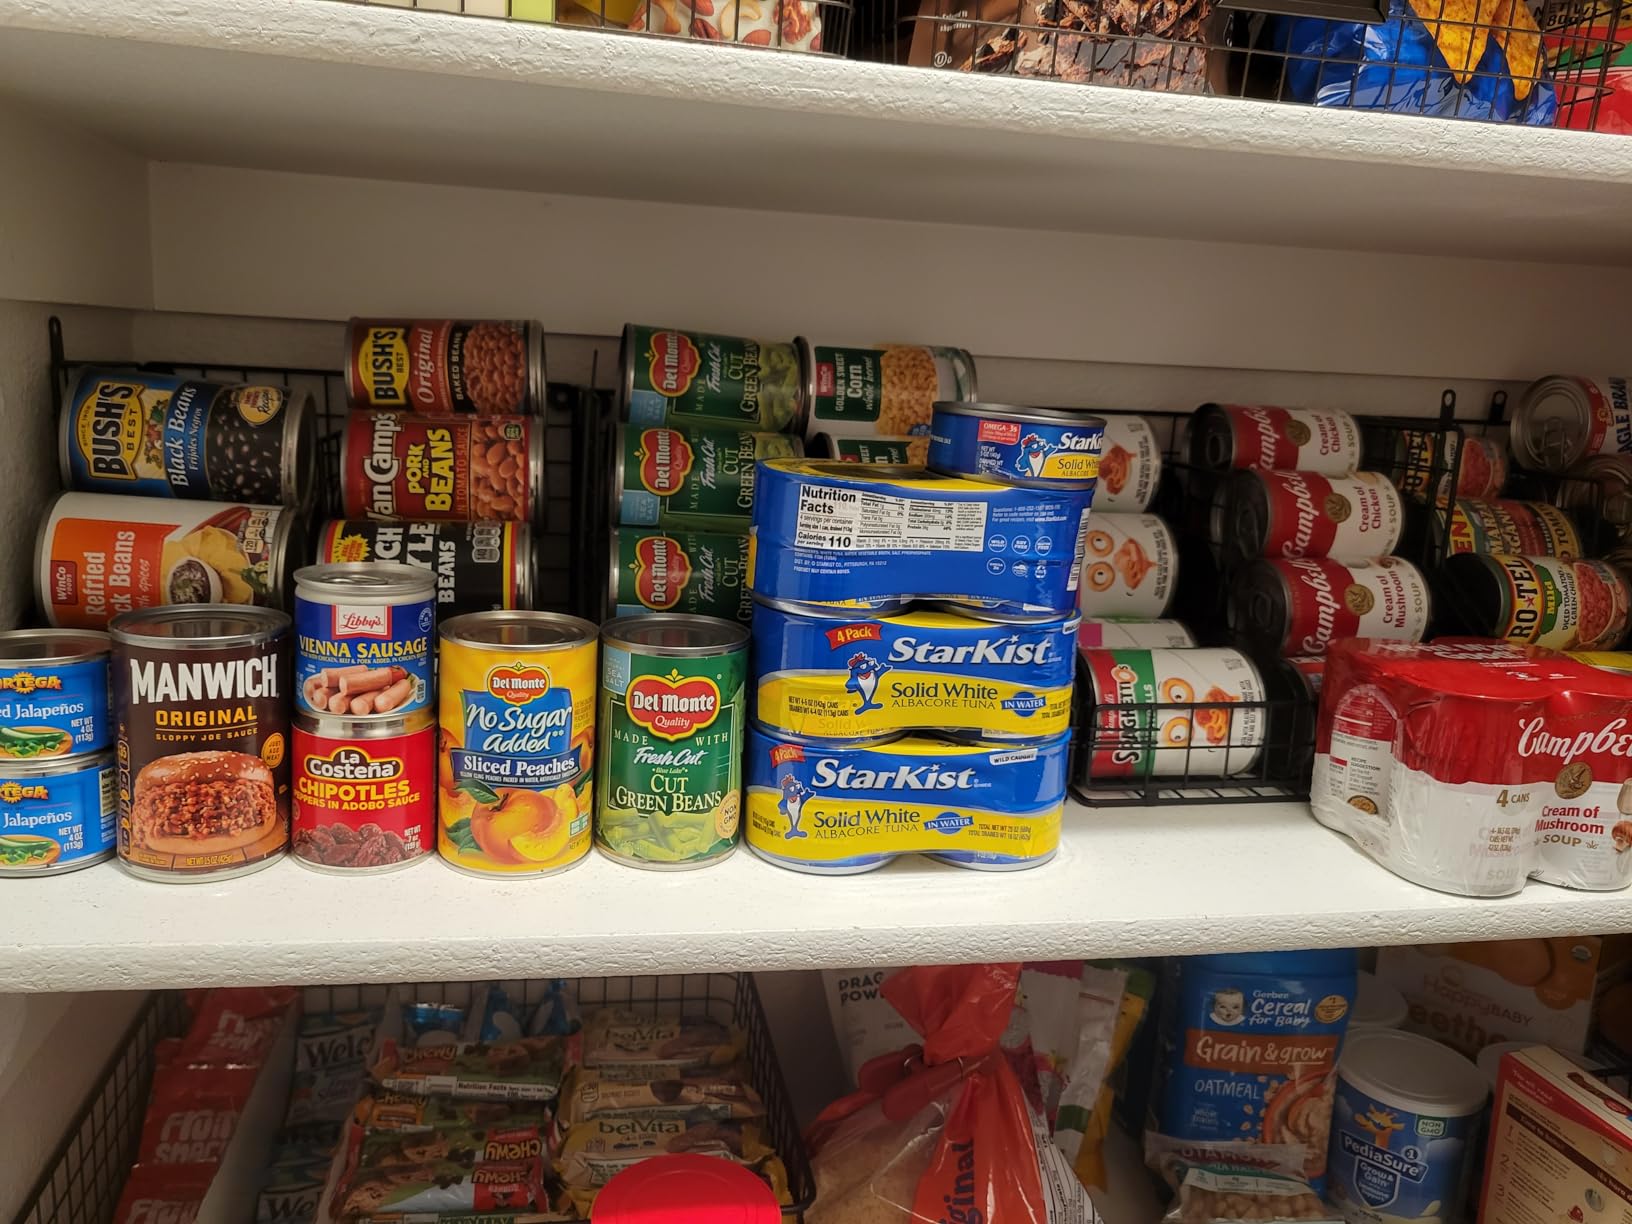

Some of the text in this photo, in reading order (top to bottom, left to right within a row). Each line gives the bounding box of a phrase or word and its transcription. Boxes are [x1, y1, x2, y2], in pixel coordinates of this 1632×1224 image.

[373, 331, 397, 399] BUSH'S
[414, 328, 435, 403] Original
[451, 332, 464, 400] BAKED BEANS
[663, 333, 679, 390] Del Monte
[728, 352, 743, 380] CUT
[705, 361, 721, 393] Fresh
[835, 353, 845, 411] GOLDEN SWEET
[847, 364, 862, 399] Corn
[862, 356, 873, 411] whole kernel
[696, 379, 705, 411] MADE
[740, 368, 758, 413] GREEN
[92, 384, 133, 476] BUSH'S
[127, 408, 138, 450] BEST
[166, 385, 197, 487] Black Beans
[1312, 414, 1329, 455] Cream of
[1326, 416, 1340, 453] Chicken
[189, 433, 199, 471] Frijoles
[655, 431, 670, 489] Del Monte
[723, 448, 739, 475] CUT
[406, 443, 425, 494] PORK
[422, 459, 430, 479] AND
[425, 427, 455, 511] BEANS
[456, 457, 467, 496] TOMATO
[701, 457, 716, 490] Fresh
[1057, 459, 1083, 470] Solid
[690, 476, 700, 510] MADE
[737, 460, 753, 508] GREEN
[802, 486, 856, 502] Nutrition
[800, 500, 834, 514] Facts
[1353, 486, 1369, 532] Cream of
[1369, 488, 1380, 529] Chicken
[1388, 493, 1396, 524] SOUP
[798, 532, 826, 541] Calories
[829, 536, 851, 548] 110
[109, 531, 135, 587] Beans
[651, 539, 666, 603] Del Monte
[57, 566, 66, 600] WinCo
[82, 552, 106, 616] Refried
[136, 559, 150, 592] spices
[438, 541, 456, 603] BEANS
[721, 558, 738, 588] CUT
[699, 569, 714, 603] Fresh
[1413, 584, 1422, 612] SOUP
[1376, 575, 1393, 624] Cream of
[1389, 570, 1406, 628] Mushroom
[1569, 597, 1577, 619] GREEN
[342, 613, 383, 629] Libby's
[1562, 605, 1571, 631] DICED
[299, 634, 351, 657] VIENNA
[357, 637, 427, 658] SAUSAGE
[837, 626, 872, 642] 4 Pack
[888, 634, 1051, 664] StarKist
[0, 675, 62, 690] RTEGA
[130, 653, 278, 704] MANWICH
[492, 677, 545, 689] Del Monte
[607, 668, 622, 679] SEA
[633, 691, 715, 712] Del Monte
[891, 682, 998, 699] Solid White
[15, 703, 84, 719] Jalapeños
[892, 699, 996, 710] ALBACORE TUNA
[1004, 699, 1045, 709] IN WATER
[71, 716, 93, 727] NET WT
[86, 724, 93, 732] OZ
[156, 706, 258, 727] ORIGINAL
[466, 704, 497, 731] No
[498, 706, 572, 737] Sugar
[655, 715, 690, 729] Quality
[156, 728, 258, 742] SLOPPY JOE SAUCE
[269, 740, 281, 748] JUST
[614, 729, 729, 746] MADE WITH
[340, 751, 360, 764] La
[464, 756, 575, 777] Sliced Peaches
[634, 746, 672, 765] Fresh
[774, 750, 798, 762] 4 Pack
[310, 760, 394, 779] Costeña
[811, 759, 976, 790] StarKist
[0, 785, 48, 800] TEGA
[299, 777, 410, 801] CHIPOTLES
[650, 774, 689, 793] CUT
[328, 801, 339, 809] IN
[342, 801, 385, 810] ADOBO
[387, 792, 420, 808] SAUCE
[616, 786, 721, 812] GREEN BEANS
[1496, 790, 1530, 807] 4 CANS
[3, 812, 73, 828] Jalapeños
[814, 808, 920, 828] Solid White
[927, 818, 971, 830] IN WATER
[1542, 806, 1600, 818] Cream of
[59, 824, 82, 836] NET WT
[75, 832, 83, 840] OZ
[815, 825, 919, 839] ALBACORE TUNA
[1535, 818, 1604, 834] Mushroom
[1543, 834, 1582, 846] SOUP
[1253, 990, 1289, 999] Gerber
[1251, 999, 1310, 1015] Cereal
[1249, 1015, 1310, 1028] for Baby
[1196, 1035, 1327, 1065] Grain & grow
[1195, 1079, 1261, 1099] OATMEAL
[600, 1119, 681, 1134] belVita
[485, 1140, 543, 1161] CHEWY
[1344, 1135, 1420, 1177] PediaSure
[944, 1137, 983, 1224] ginal
[1360, 1162, 1385, 1179] Grow
[1364, 1171, 1386, 1187] Gain
